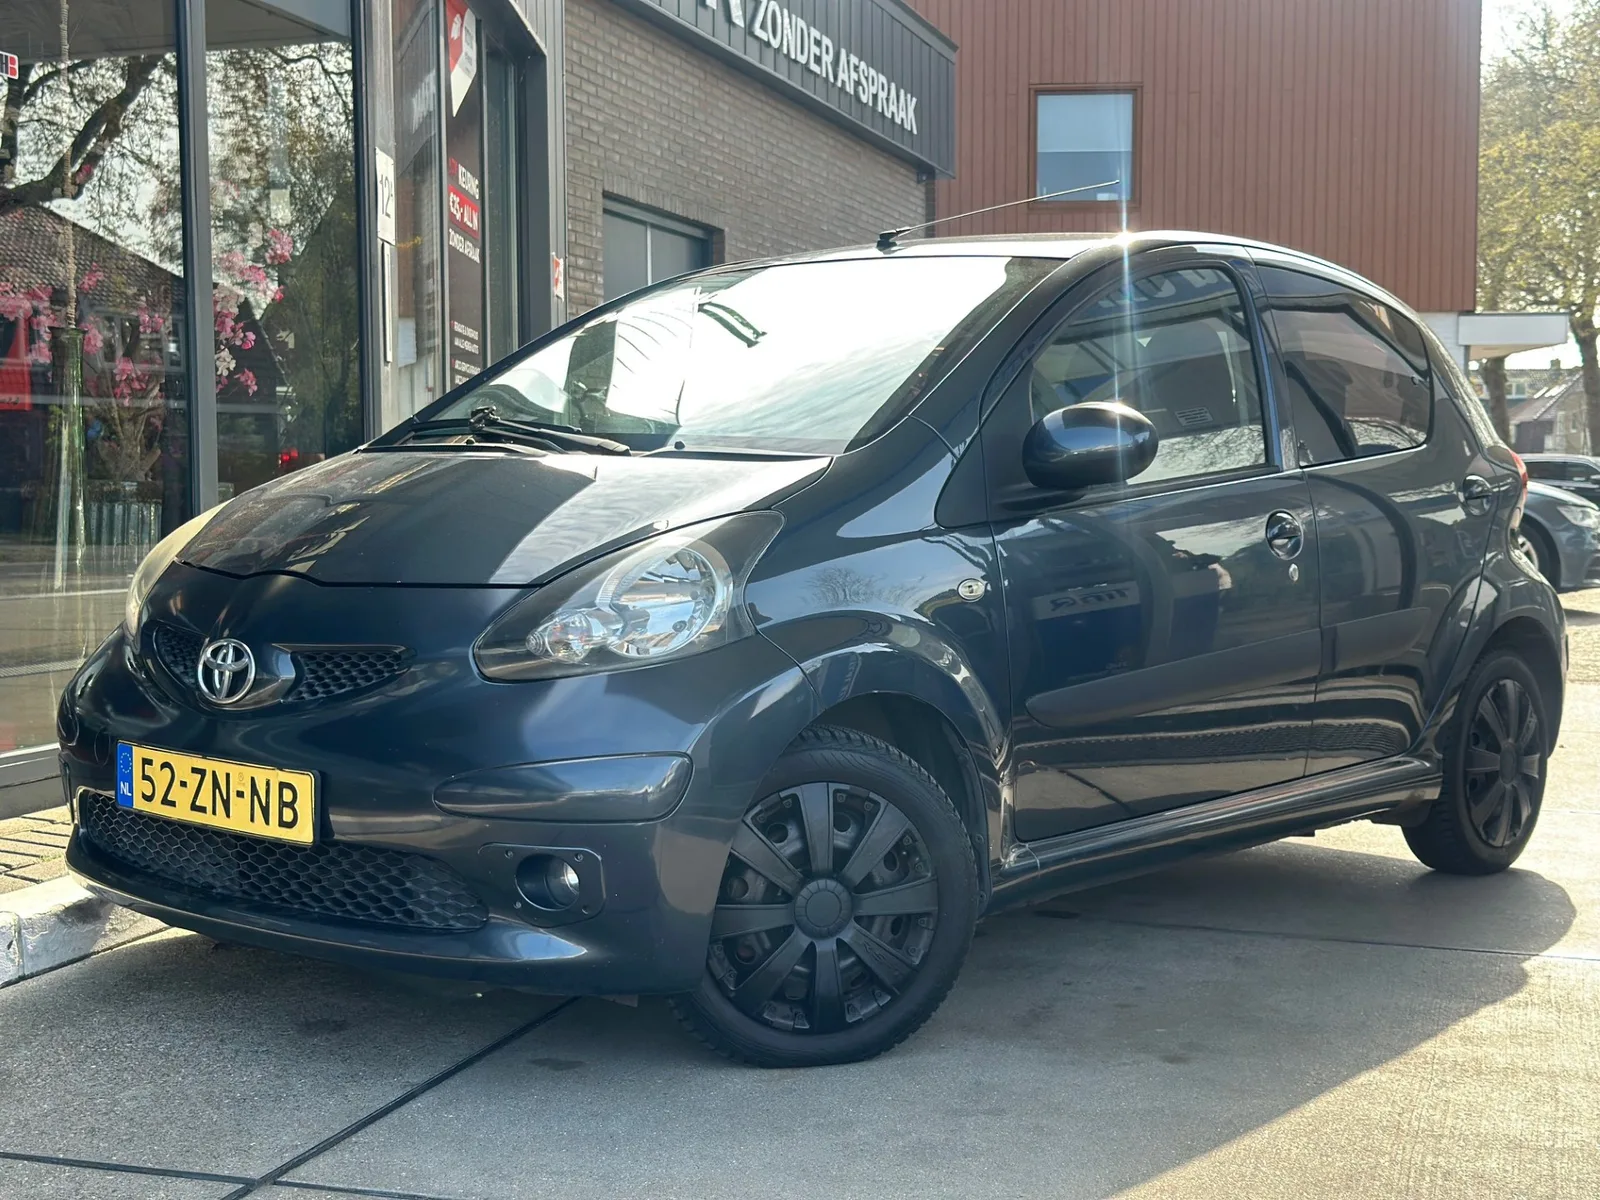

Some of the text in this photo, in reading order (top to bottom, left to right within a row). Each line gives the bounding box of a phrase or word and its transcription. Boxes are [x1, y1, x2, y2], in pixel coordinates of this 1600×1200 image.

[754, 0, 917, 135] ZONDER AFSPRAAK
[141, 757, 299, 829] 52-ZN-NB
